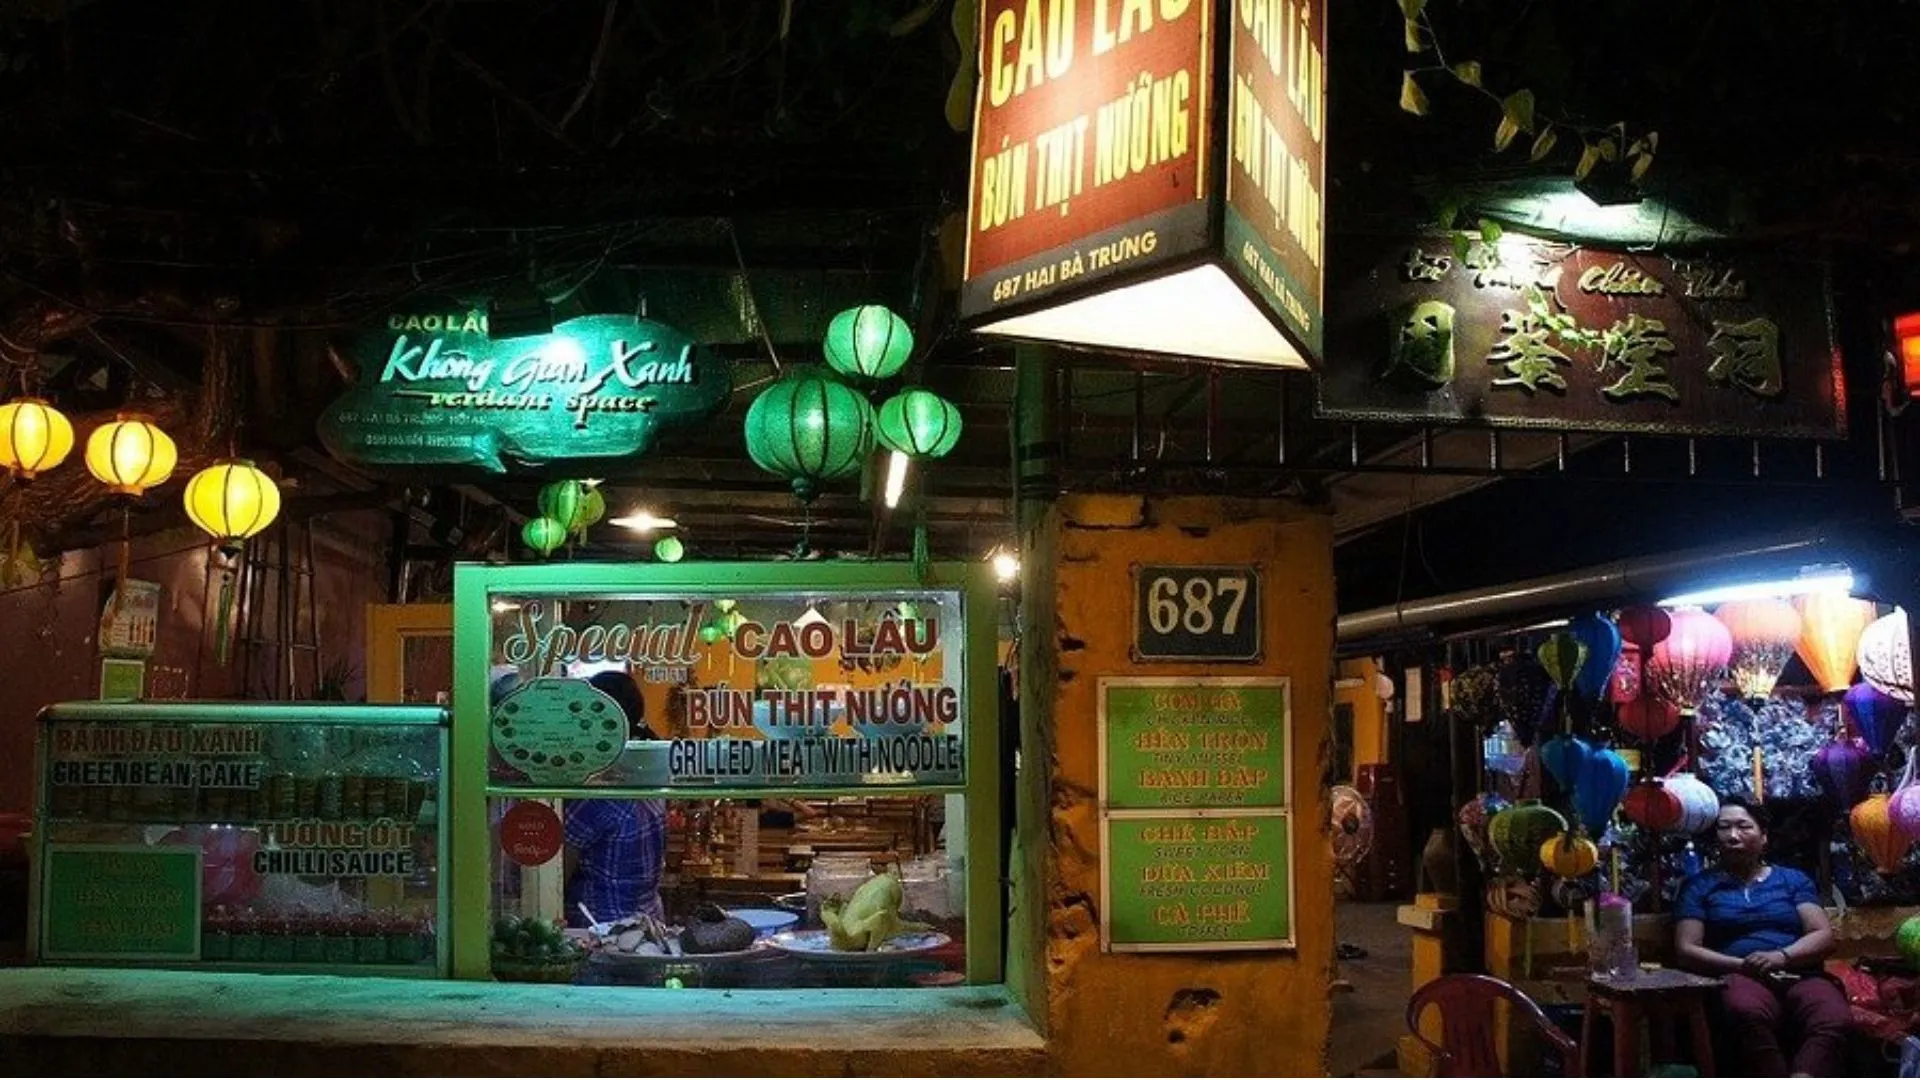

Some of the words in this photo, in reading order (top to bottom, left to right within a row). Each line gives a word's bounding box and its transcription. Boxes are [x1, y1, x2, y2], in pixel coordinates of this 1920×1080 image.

[980, 134, 1029, 232] BÚN
[1035, 115, 1089, 217] THỊT
[993, 274, 1022, 301] 687
[1025, 264, 1057, 291] HAI
[1060, 251, 1084, 281] BÀ
[1088, 230, 1158, 271] TRƯNG
[388, 312, 442, 332] CAO
[580, 338, 693, 394] Xanh
[428, 389, 550, 412] verdant
[565, 392, 655, 429] space
[1148, 577, 1248, 634] 687
[503, 600, 705, 680] Special
[734, 620, 834, 660] CAO
[687, 682, 753, 728] BÚN
[846, 679, 959, 727] NƯỚNG
[190, 728, 261, 754] XANH
[669, 737, 755, 777] GRILLED
[763, 736, 816, 776] MEAT
[820, 736, 871, 774] WITH
[877, 733, 960, 773] NOODLE
[199, 761, 260, 788] CAKE
[253, 849, 328, 875] CHILLI
[330, 849, 414, 876] SAUCE
